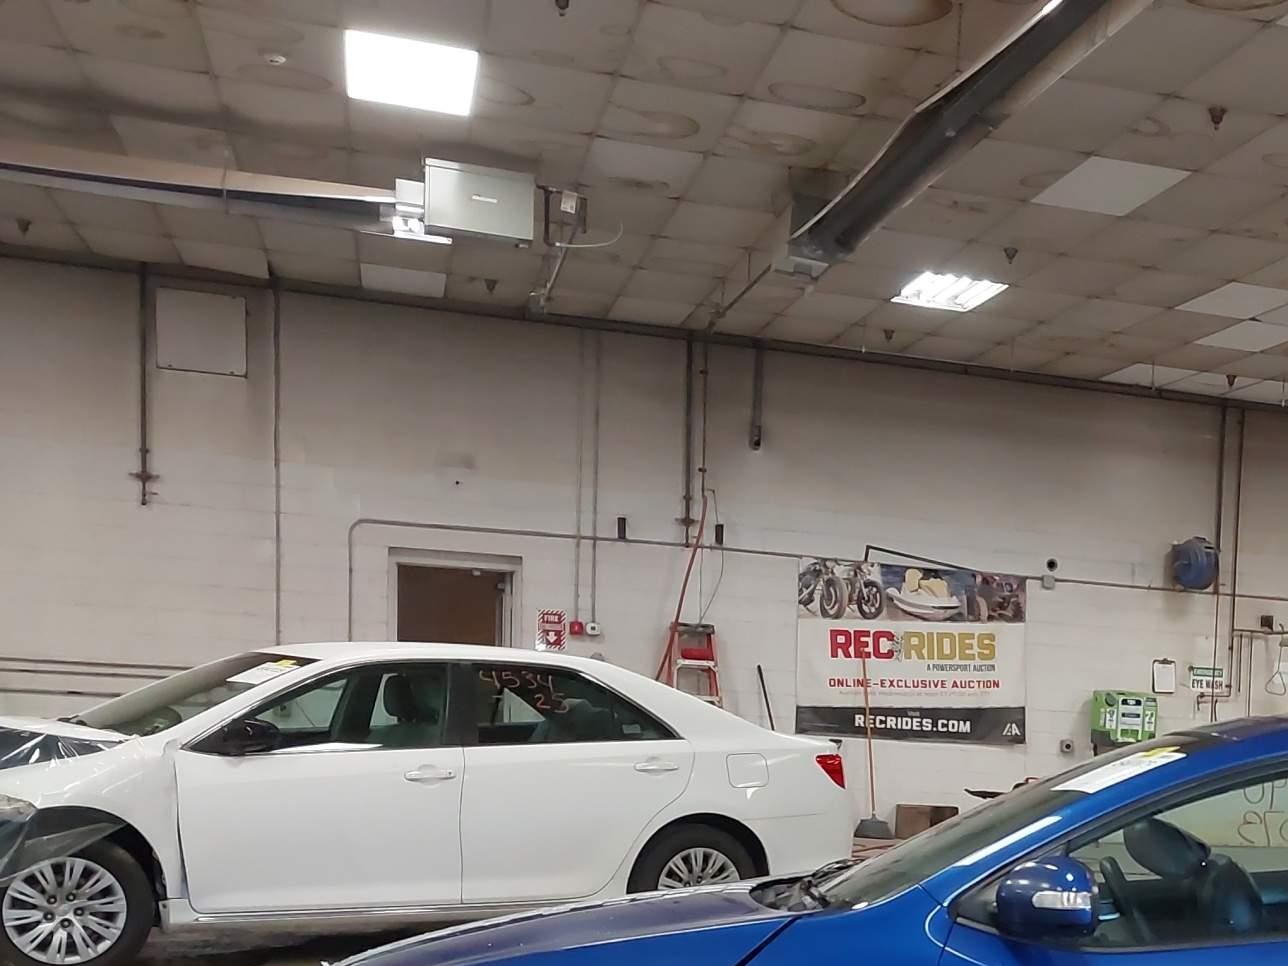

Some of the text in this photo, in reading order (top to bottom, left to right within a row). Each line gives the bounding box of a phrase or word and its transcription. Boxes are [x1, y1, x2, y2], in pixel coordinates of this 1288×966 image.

[829, 629, 997, 662] REC RIDES
[932, 664, 971, 673] POWERSPORT
[972, 664, 996, 673] AUCTION
[479, 669, 554, 693] 4534
[828, 678, 1001, 690] ONLINE-EXCLUSIVE AUCTION
[1191, 678, 1204, 689] EYE
[854, 714, 971, 734] RECRIDES.COM
